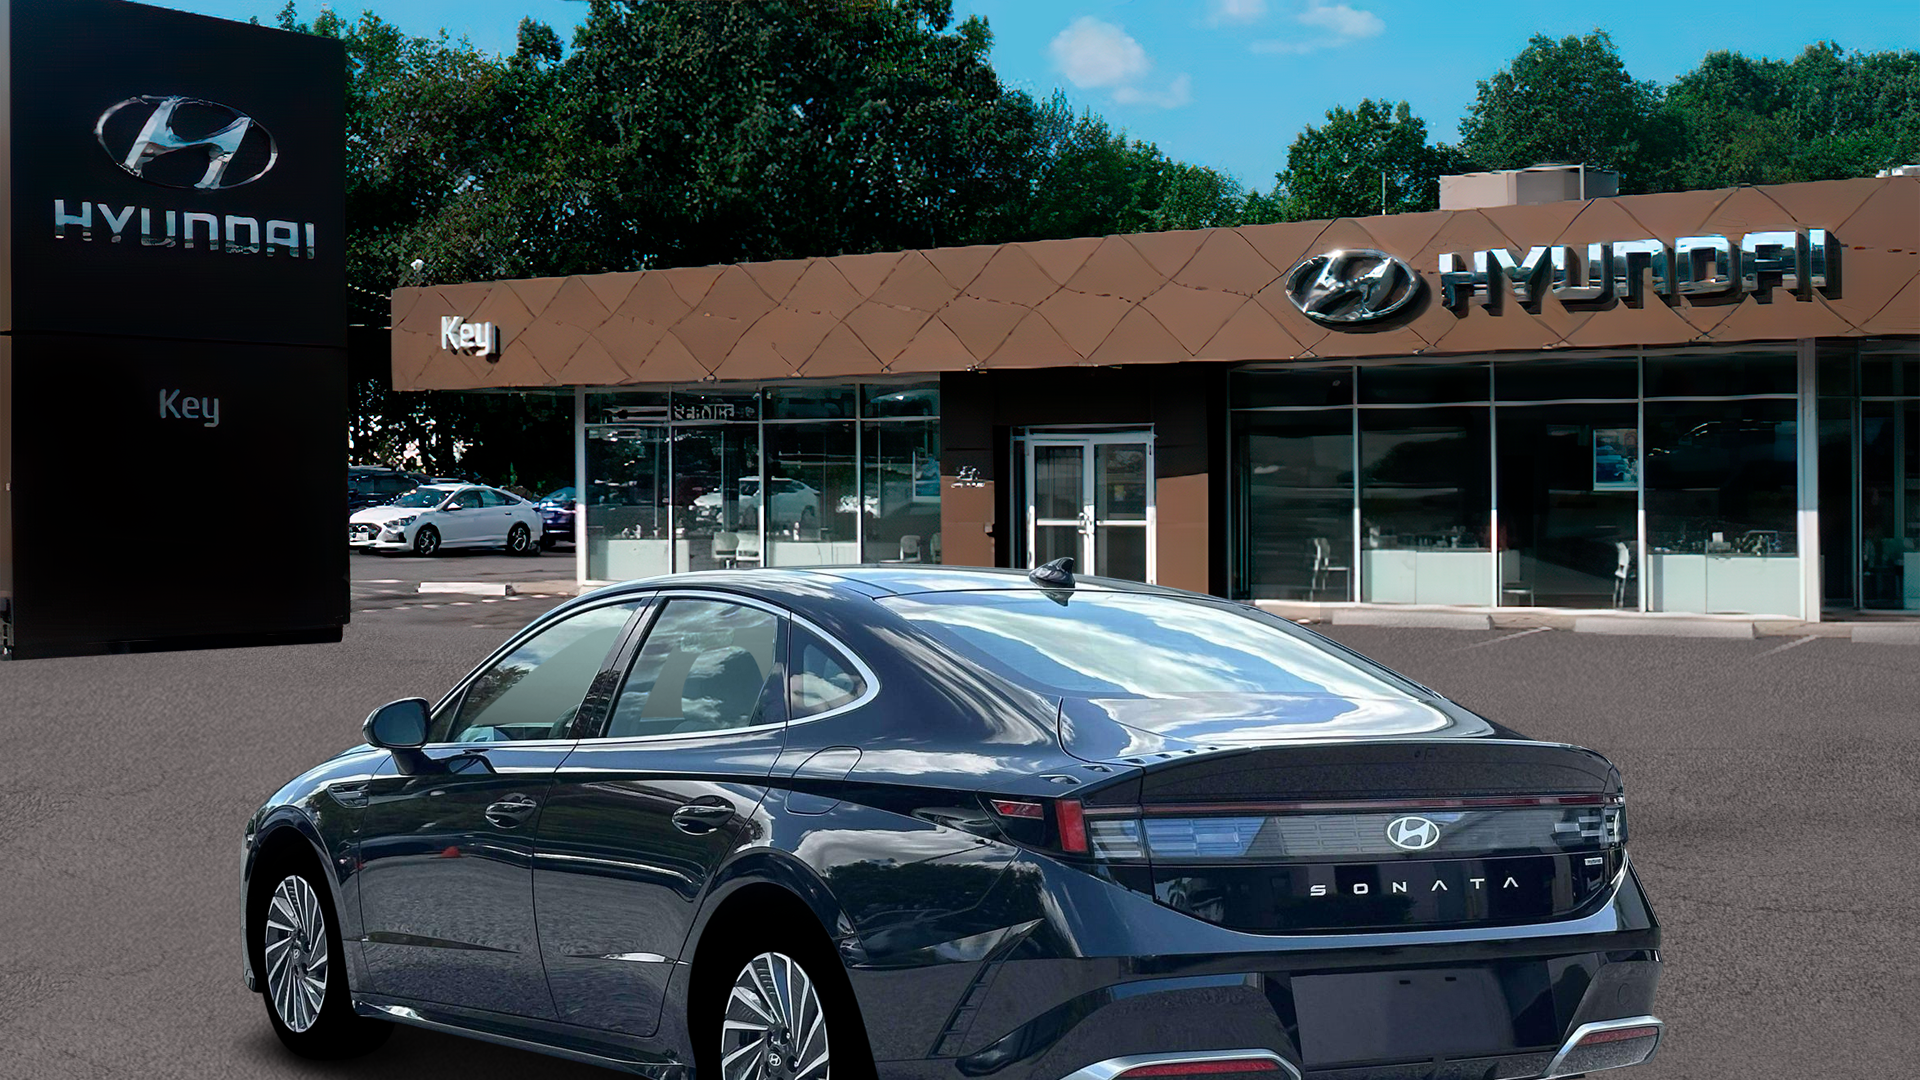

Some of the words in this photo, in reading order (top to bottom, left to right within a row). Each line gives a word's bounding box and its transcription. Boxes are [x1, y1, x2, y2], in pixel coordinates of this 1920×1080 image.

[54, 198, 316, 260] HYUNDAI
[1438, 228, 1840, 316] HYUNDAI
[440, 315, 497, 357] Key
[158, 388, 220, 428] Key
[1310, 876, 1519, 897] SONATA
